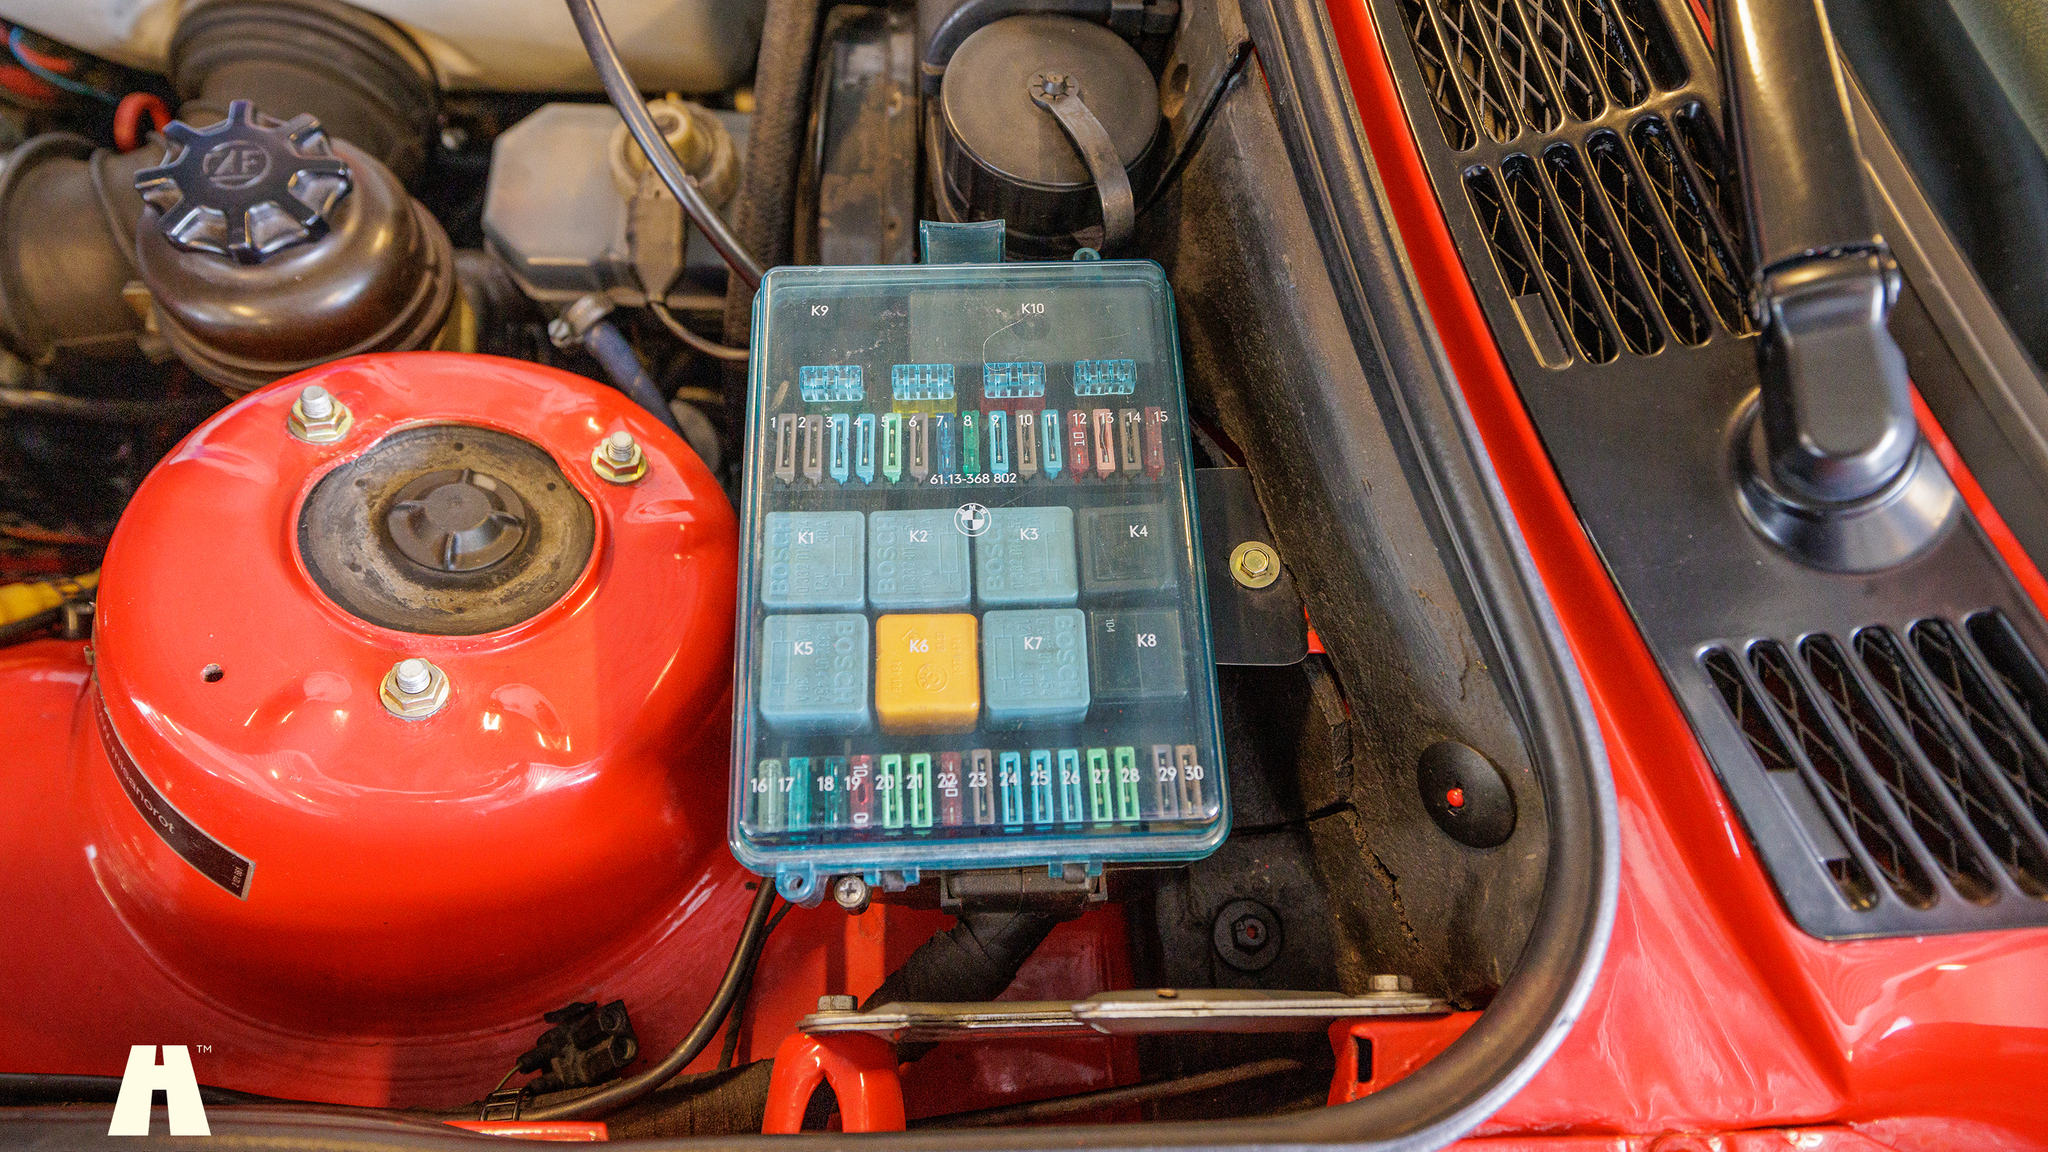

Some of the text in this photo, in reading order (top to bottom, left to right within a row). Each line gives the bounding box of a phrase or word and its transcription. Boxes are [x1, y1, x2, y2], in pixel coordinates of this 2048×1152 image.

[811, 305, 829, 316] K9
[1021, 303, 1045, 314] K10
[770, 411, 1168, 428] 1 2 3 4 5 6 7 8 9 10 11 12 13 14 15
[1073, 431, 1085, 446] 10
[930, 473, 1017, 484] 61.13-368 802
[798, 531, 814, 544] K1
[910, 530, 928, 542] K2
[1020, 528, 1039, 540] K3
[1129, 525, 1148, 538] K4
[770, 518, 792, 595] BOSCH
[877, 517, 897, 594] BOSCH
[1105, 619, 1115, 633] 104
[909, 639, 929, 653] K6
[1024, 636, 1042, 650] K7
[1137, 633, 1157, 647] K8
[794, 641, 814, 656] K5
[834, 621, 855, 703] BOSCH
[1055, 615, 1079, 697] BOSCH
[750, 765, 1204, 793] 16 17 18 19 20 21 22 23 24 25 26 27 28 29 30
